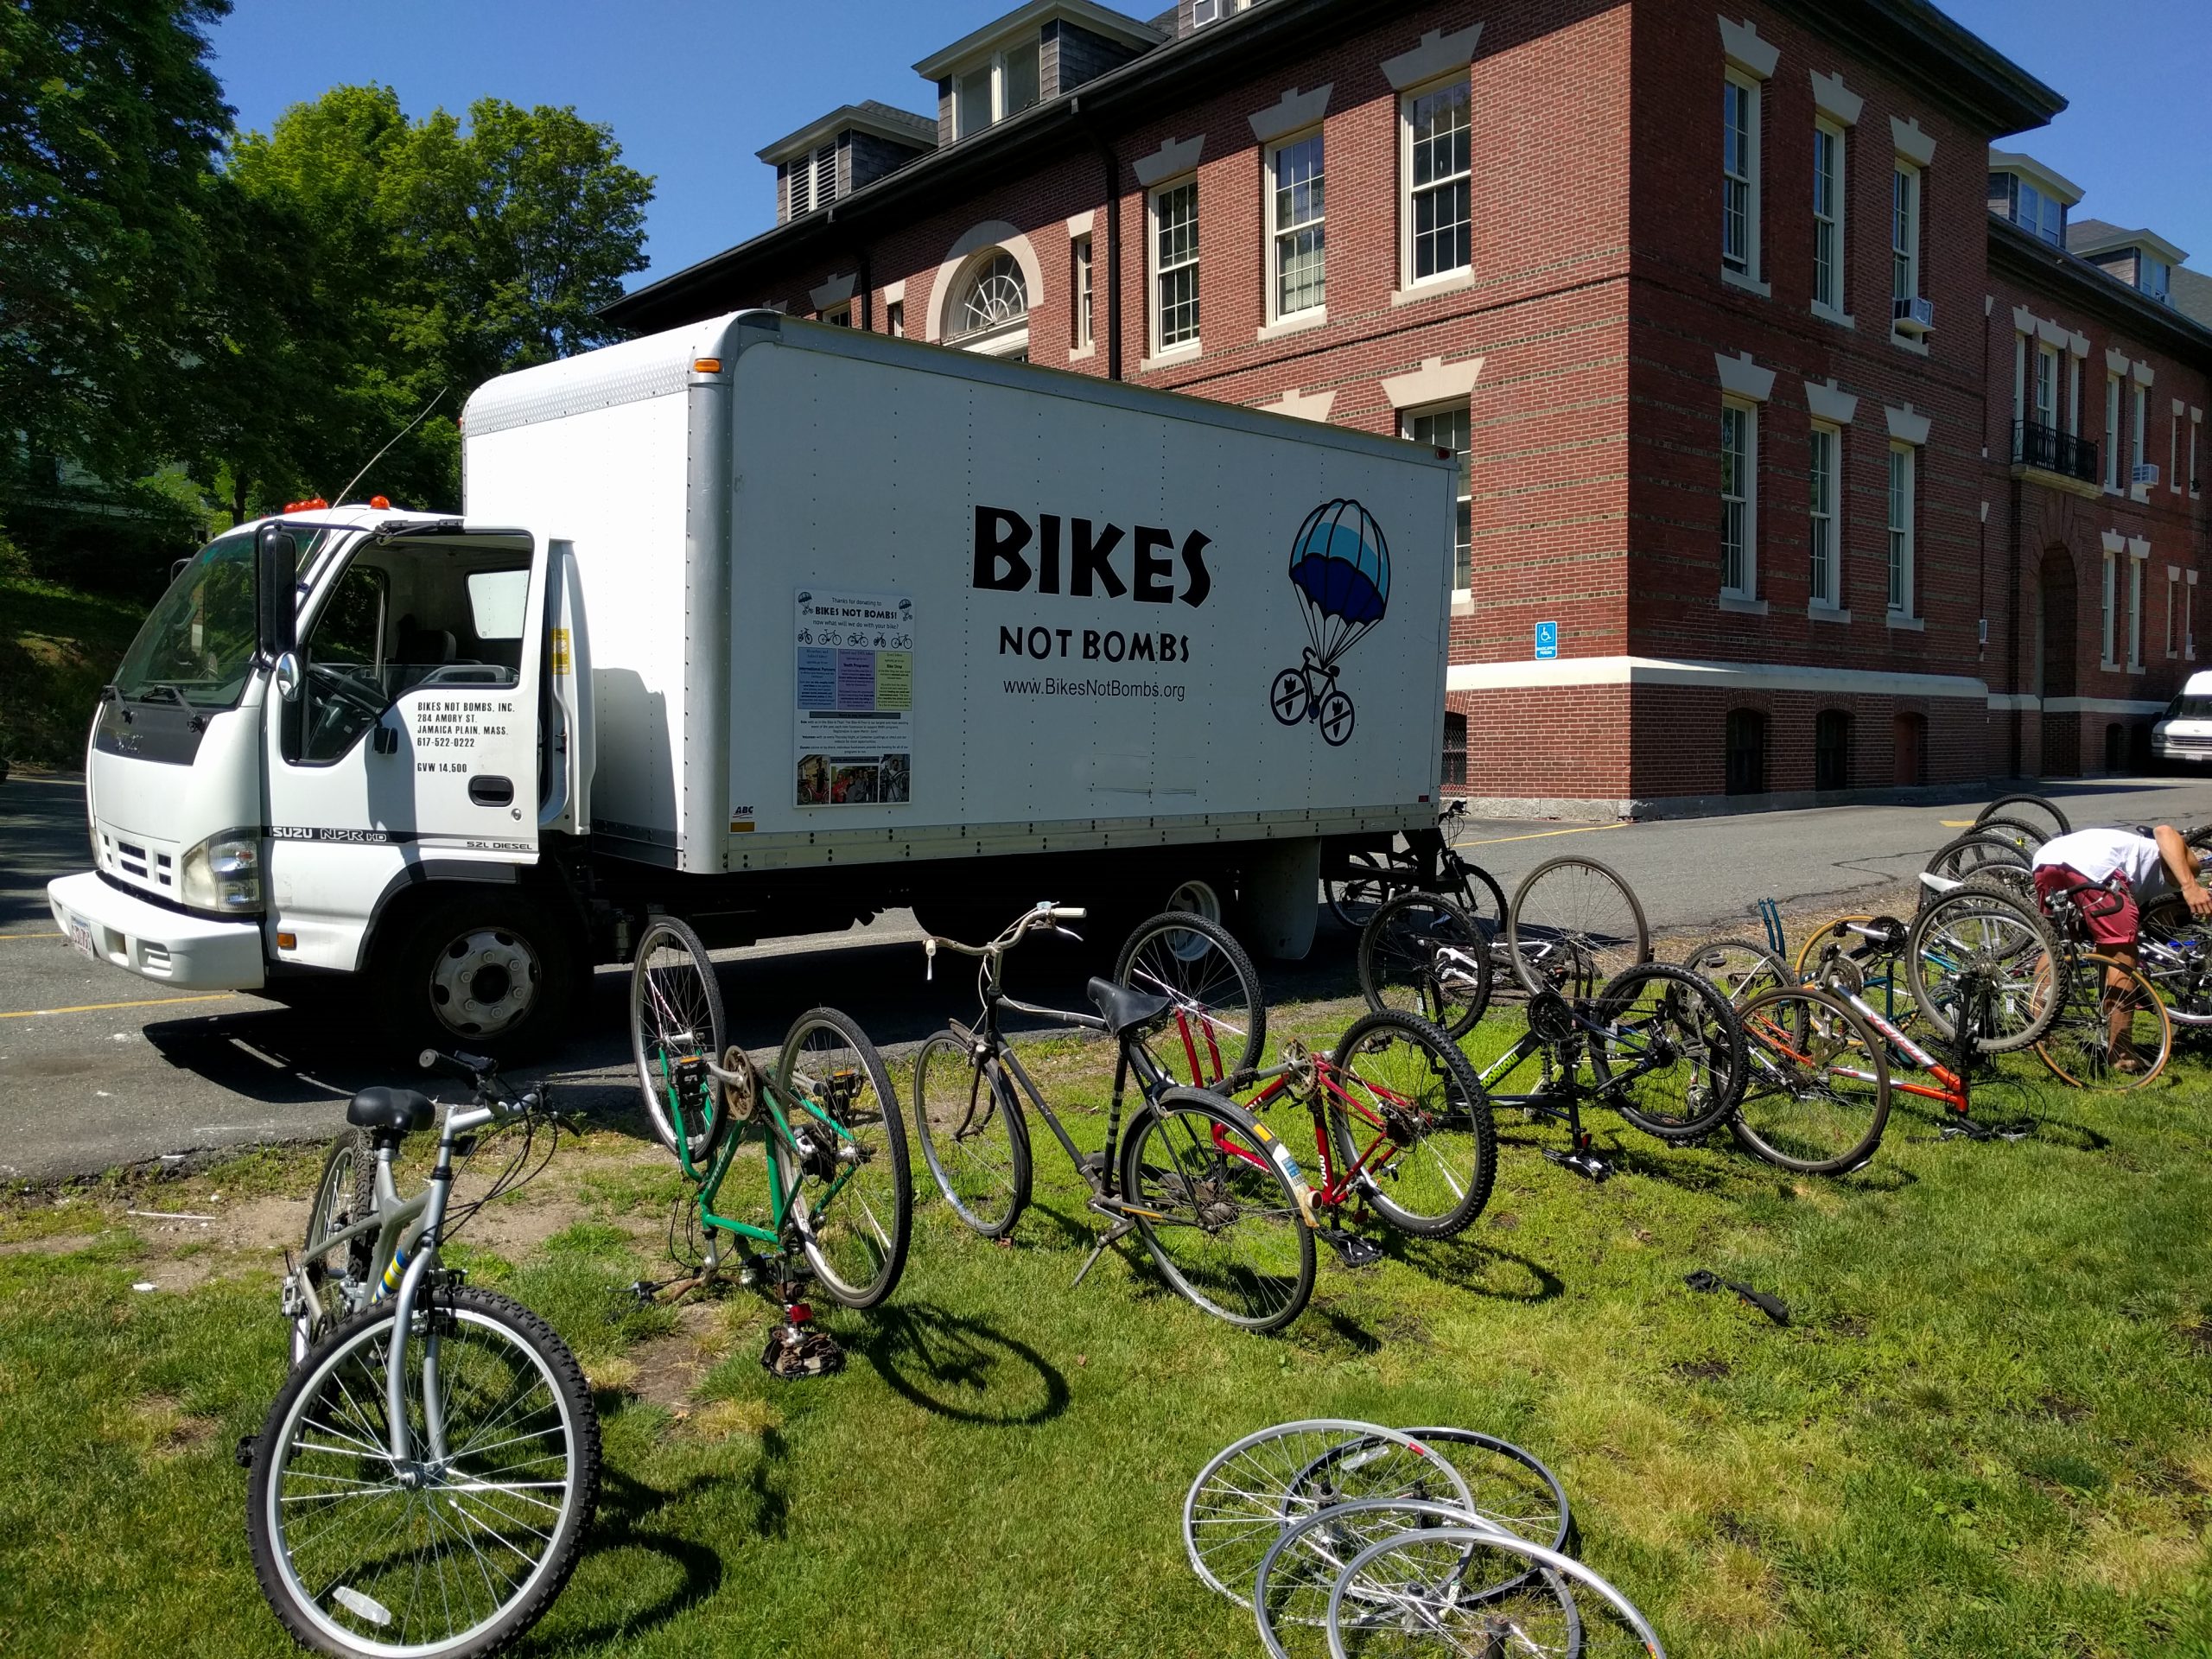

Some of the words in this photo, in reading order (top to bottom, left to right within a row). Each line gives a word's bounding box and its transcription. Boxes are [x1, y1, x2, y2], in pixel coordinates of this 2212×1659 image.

[972, 505, 1212, 608] BIKES
[815, 607, 839, 616] BIKES
[842, 607, 861, 618] NOT
[864, 610, 898, 620] BOMBS!
[999, 626, 1072, 659] NOT
[1082, 629, 1190, 663] BOMBS
[1003, 677, 1185, 701] www.BikesNotBombs.org
[417, 702, 442, 711] BIKES
[444, 702, 460, 711] NOT
[463, 702, 495, 712] BOMBS,
[498, 702, 515, 712] INC.
[417, 714, 432, 722] 284
[435, 715, 462, 723] AMORY
[466, 715, 478, 723] ST.
[417, 725, 453, 734] JAMAICA
[483, 727, 509, 735] MASS.
[417, 737, 475, 747] 617-522-0222
[417, 763, 435, 772] GVW
[735, 805, 754, 814] ABC
[270, 826, 313, 839] ISUZU
[320, 828, 365, 842] NPR
[366, 833, 387, 842] HD
[1480, 1052, 1521, 1089] mongoos
